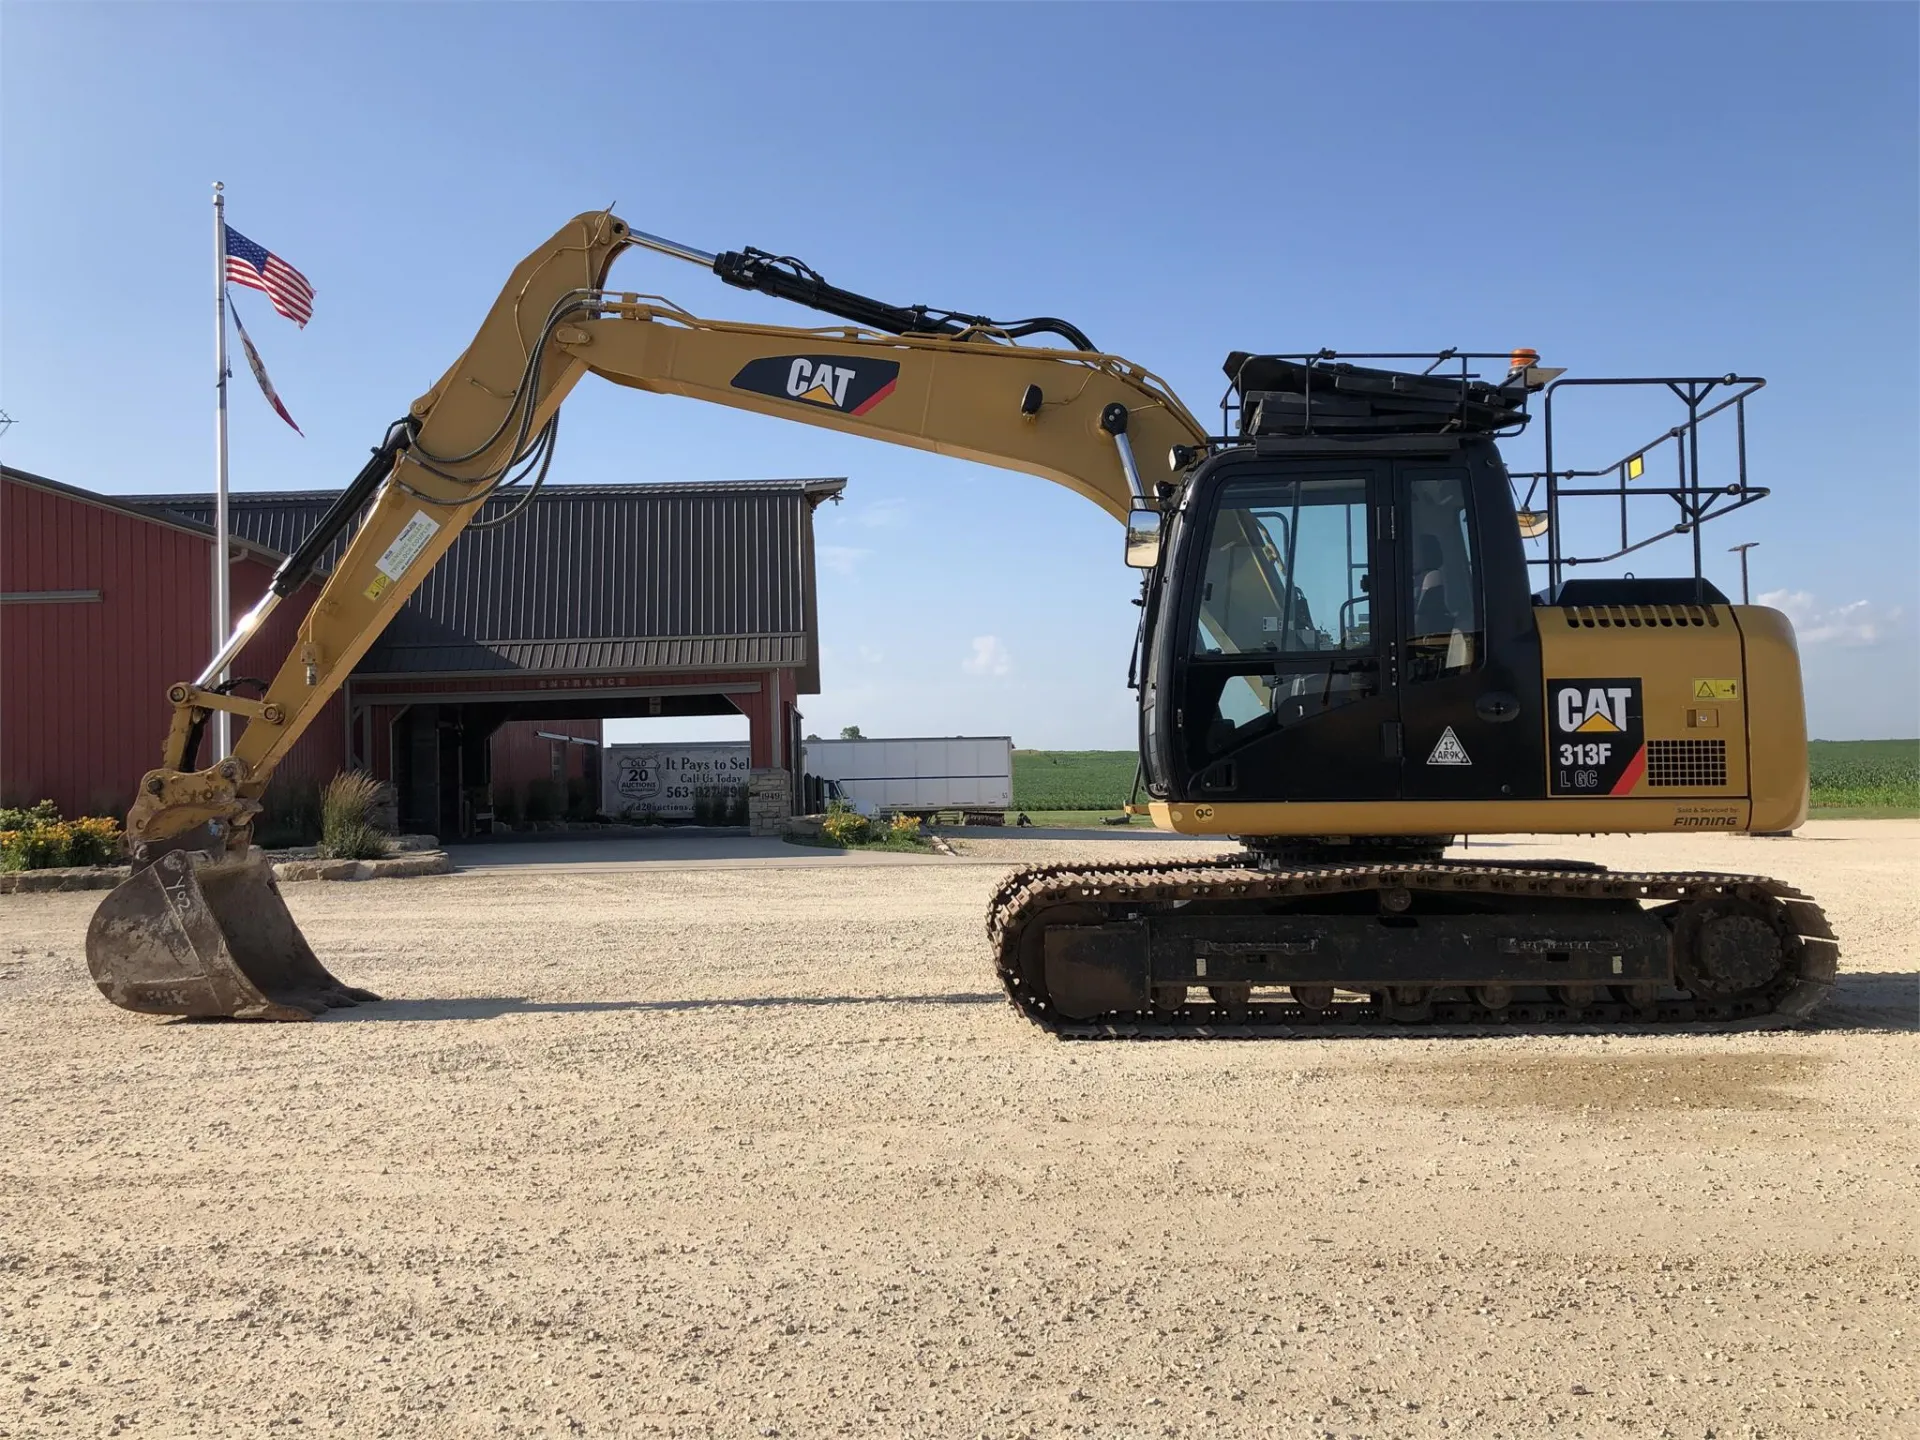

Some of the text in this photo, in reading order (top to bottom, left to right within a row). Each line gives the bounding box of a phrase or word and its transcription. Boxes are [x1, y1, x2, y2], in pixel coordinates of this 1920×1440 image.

[786, 358, 856, 407] CAT
[540, 677, 626, 688] ENTRANCE
[1558, 687, 1632, 732] CAT
[1444, 741, 1454, 750] 17
[1437, 751, 1461, 760] AR9K
[1560, 743, 1611, 766] 313F
[665, 757, 750, 772] It Pays to Sel
[629, 769, 648, 782] 20
[680, 773, 742, 785] Call Us Today
[1560, 770, 1598, 788] L GC
[621, 781, 656, 789] AUCTIONS
[1673, 817, 1737, 826] FINNING
